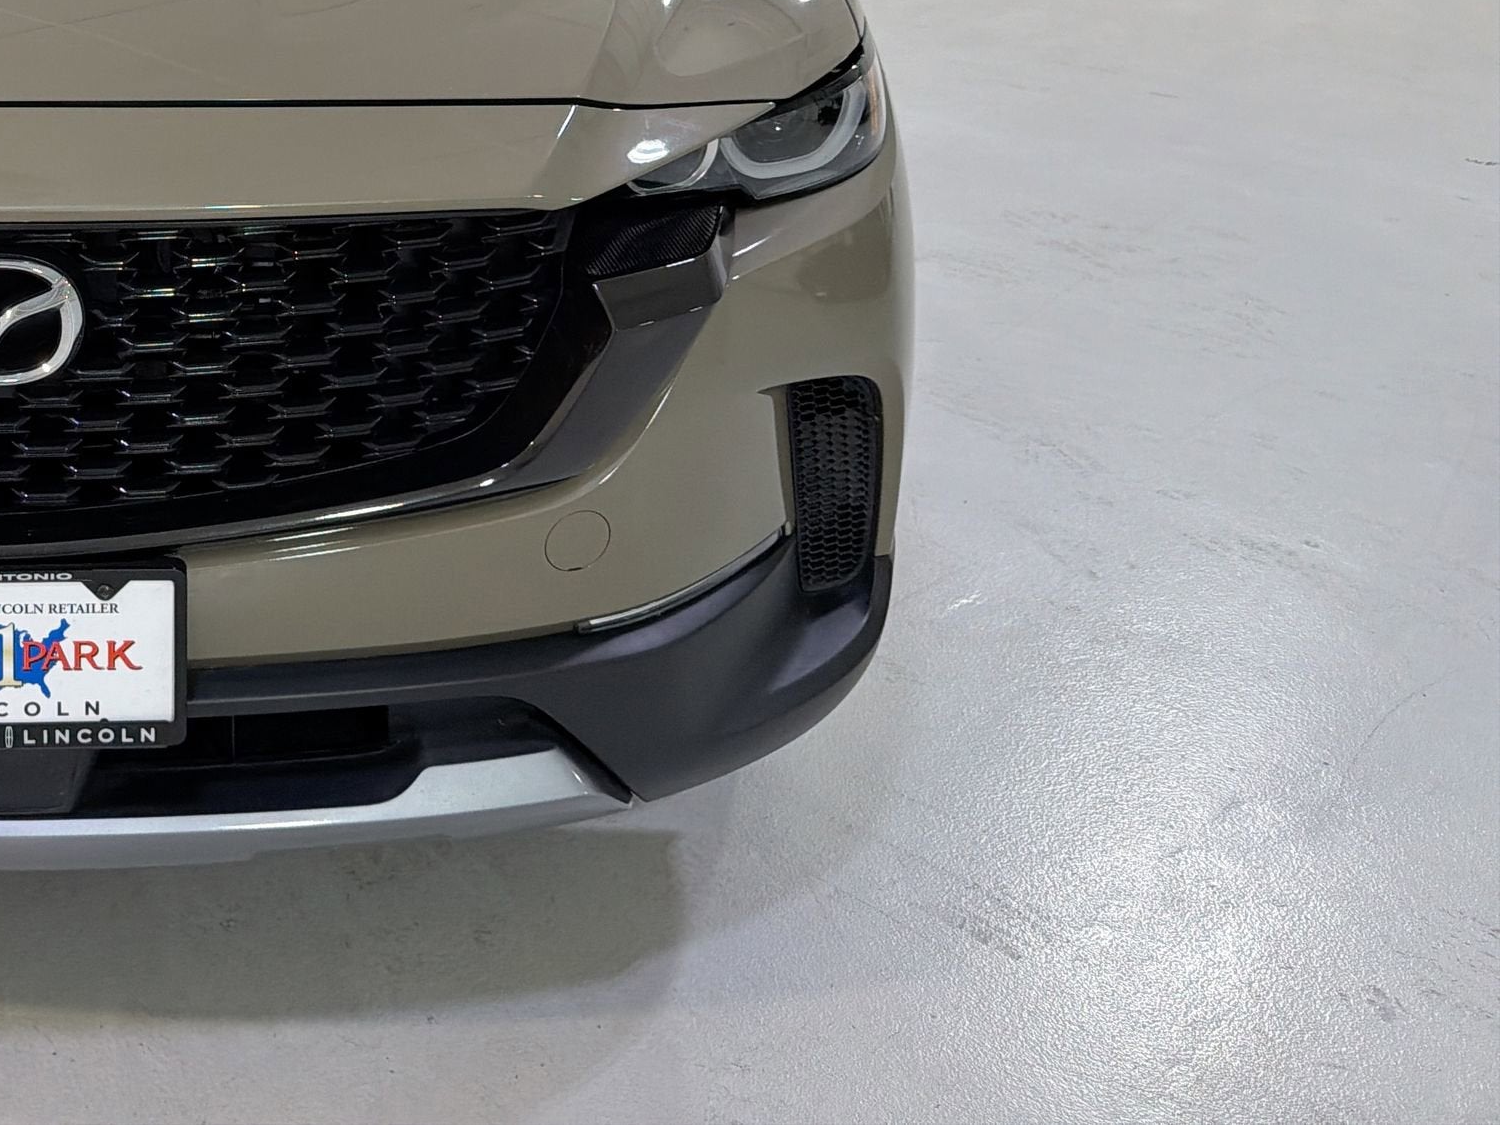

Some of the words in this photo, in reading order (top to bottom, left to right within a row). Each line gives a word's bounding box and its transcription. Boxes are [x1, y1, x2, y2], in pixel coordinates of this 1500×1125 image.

[49, 603, 120, 615] RETAILER
[21, 640, 144, 671] PARK
[22, 727, 157, 744] LINCOLN
